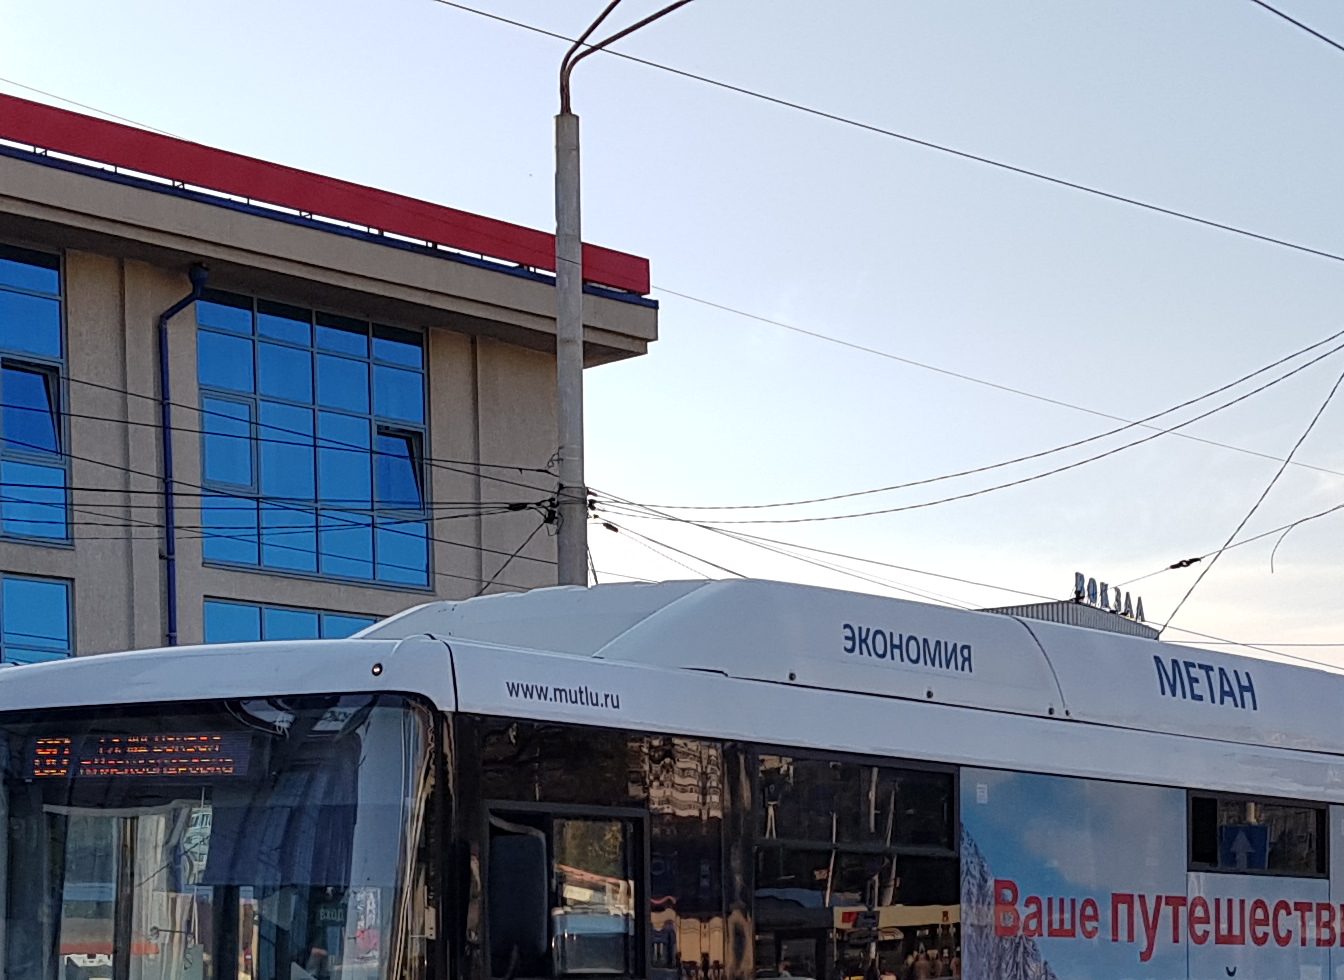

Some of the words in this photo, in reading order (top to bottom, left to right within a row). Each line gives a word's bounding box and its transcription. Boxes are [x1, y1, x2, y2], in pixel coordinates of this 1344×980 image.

[1075, 572, 1146, 622] ВОКЗАЛ
[843, 623, 973, 673] ЭКОНОМИЯ
[506, 681, 620, 709] www.mutlu.ru
[1153, 655, 1258, 711] МЕТАН
[994, 879, 1099, 938] Ваше
